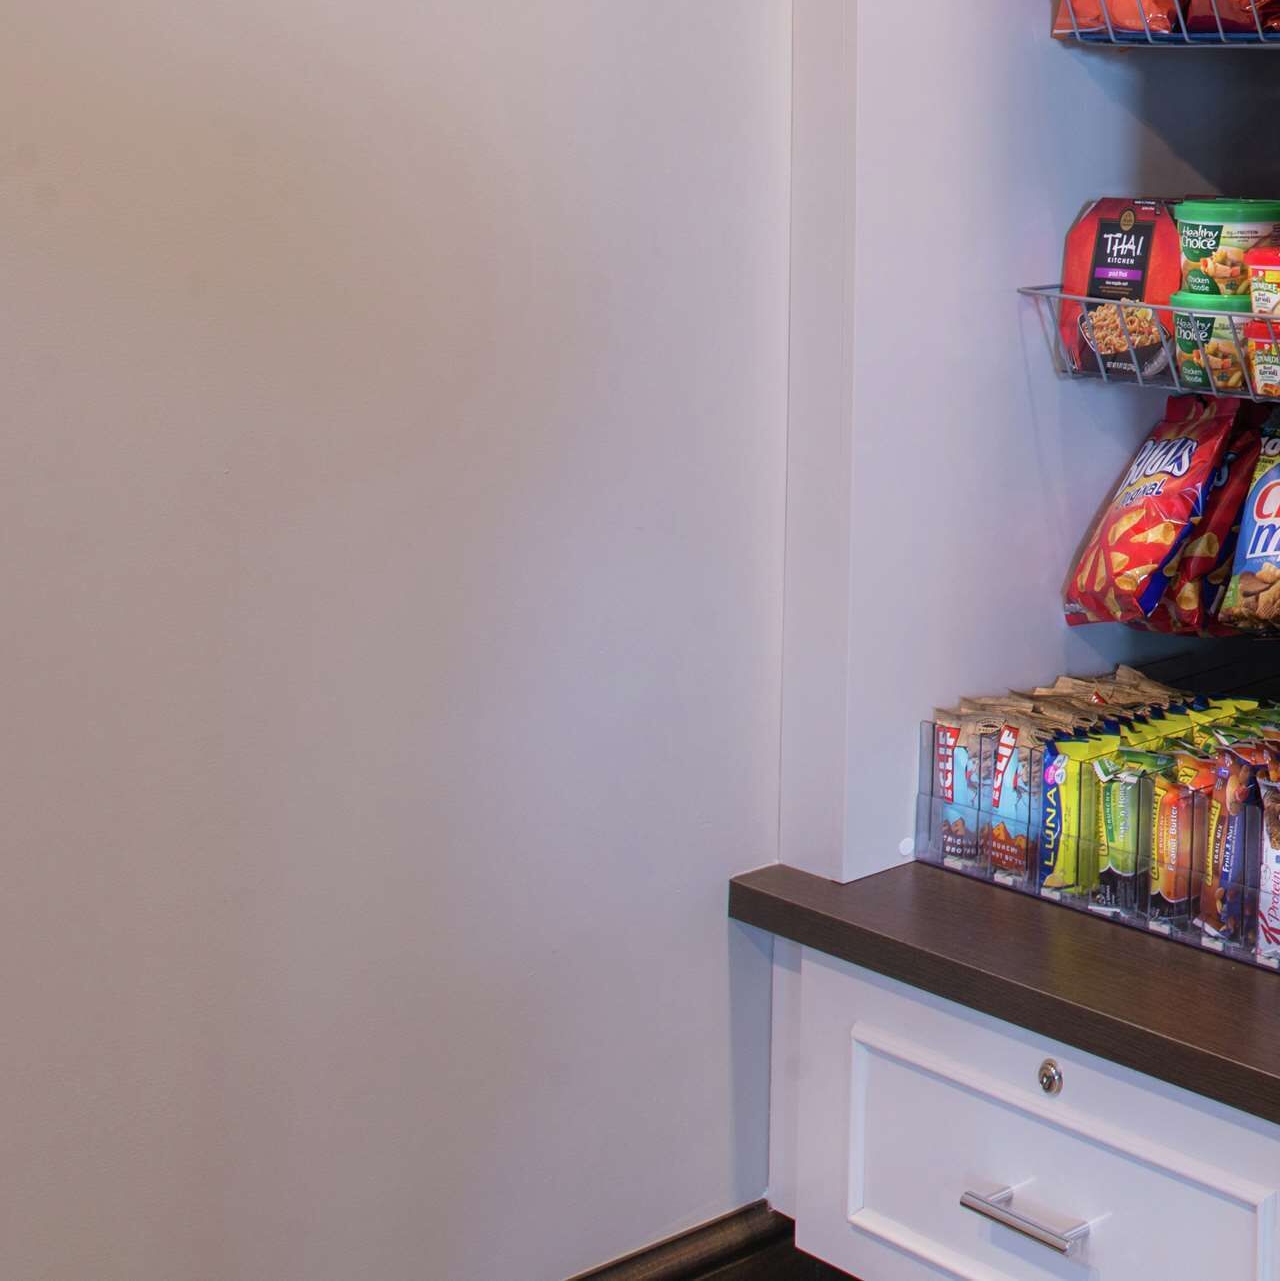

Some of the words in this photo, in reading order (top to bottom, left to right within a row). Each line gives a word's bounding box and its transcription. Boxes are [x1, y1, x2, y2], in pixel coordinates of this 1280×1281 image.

[1104, 233, 1144, 257] THAI
[1182, 225, 1219, 239] Healthy
[1182, 236, 1217, 250] Choice
[945, 731, 955, 785] CLIF
[993, 730, 1016, 785] CLIF
[1045, 787, 1057, 866] LUNA
[1268, 871, 1280, 922] Protein
